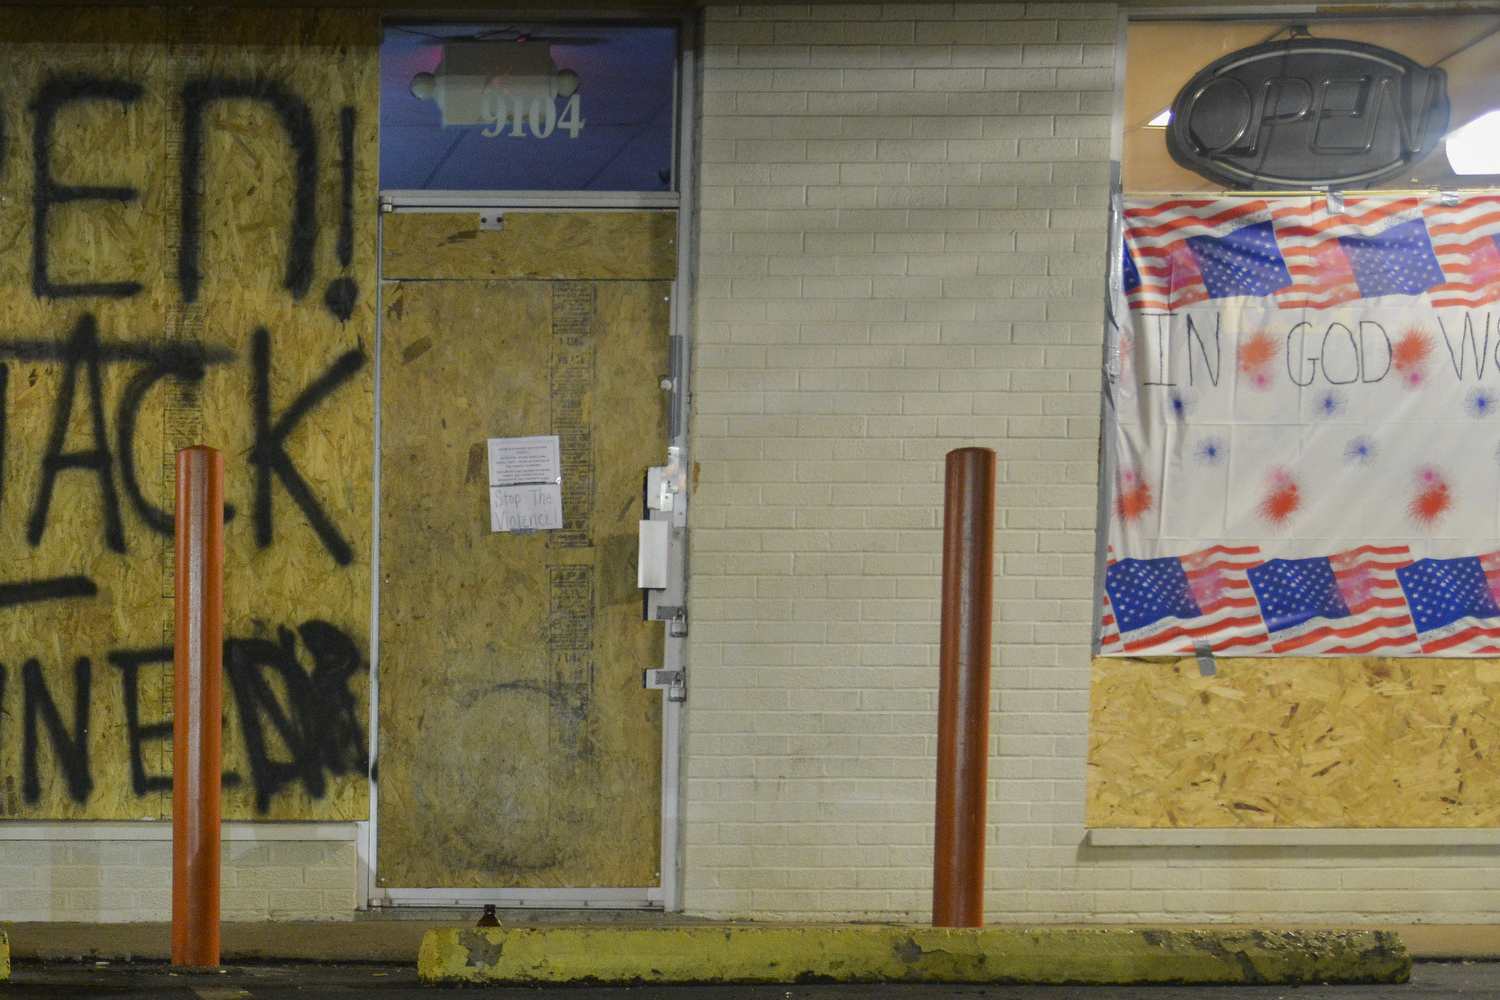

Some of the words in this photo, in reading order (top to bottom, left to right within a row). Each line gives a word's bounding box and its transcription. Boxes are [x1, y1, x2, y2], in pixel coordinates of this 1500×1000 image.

[481, 94, 585, 138] 9104
[1185, 74, 1440, 158] OPEN
[1139, 311, 1221, 387] IN
[1286, 320, 1393, 387] GOD
[494, 489, 521, 508] Stop
[528, 488, 553, 506] The
